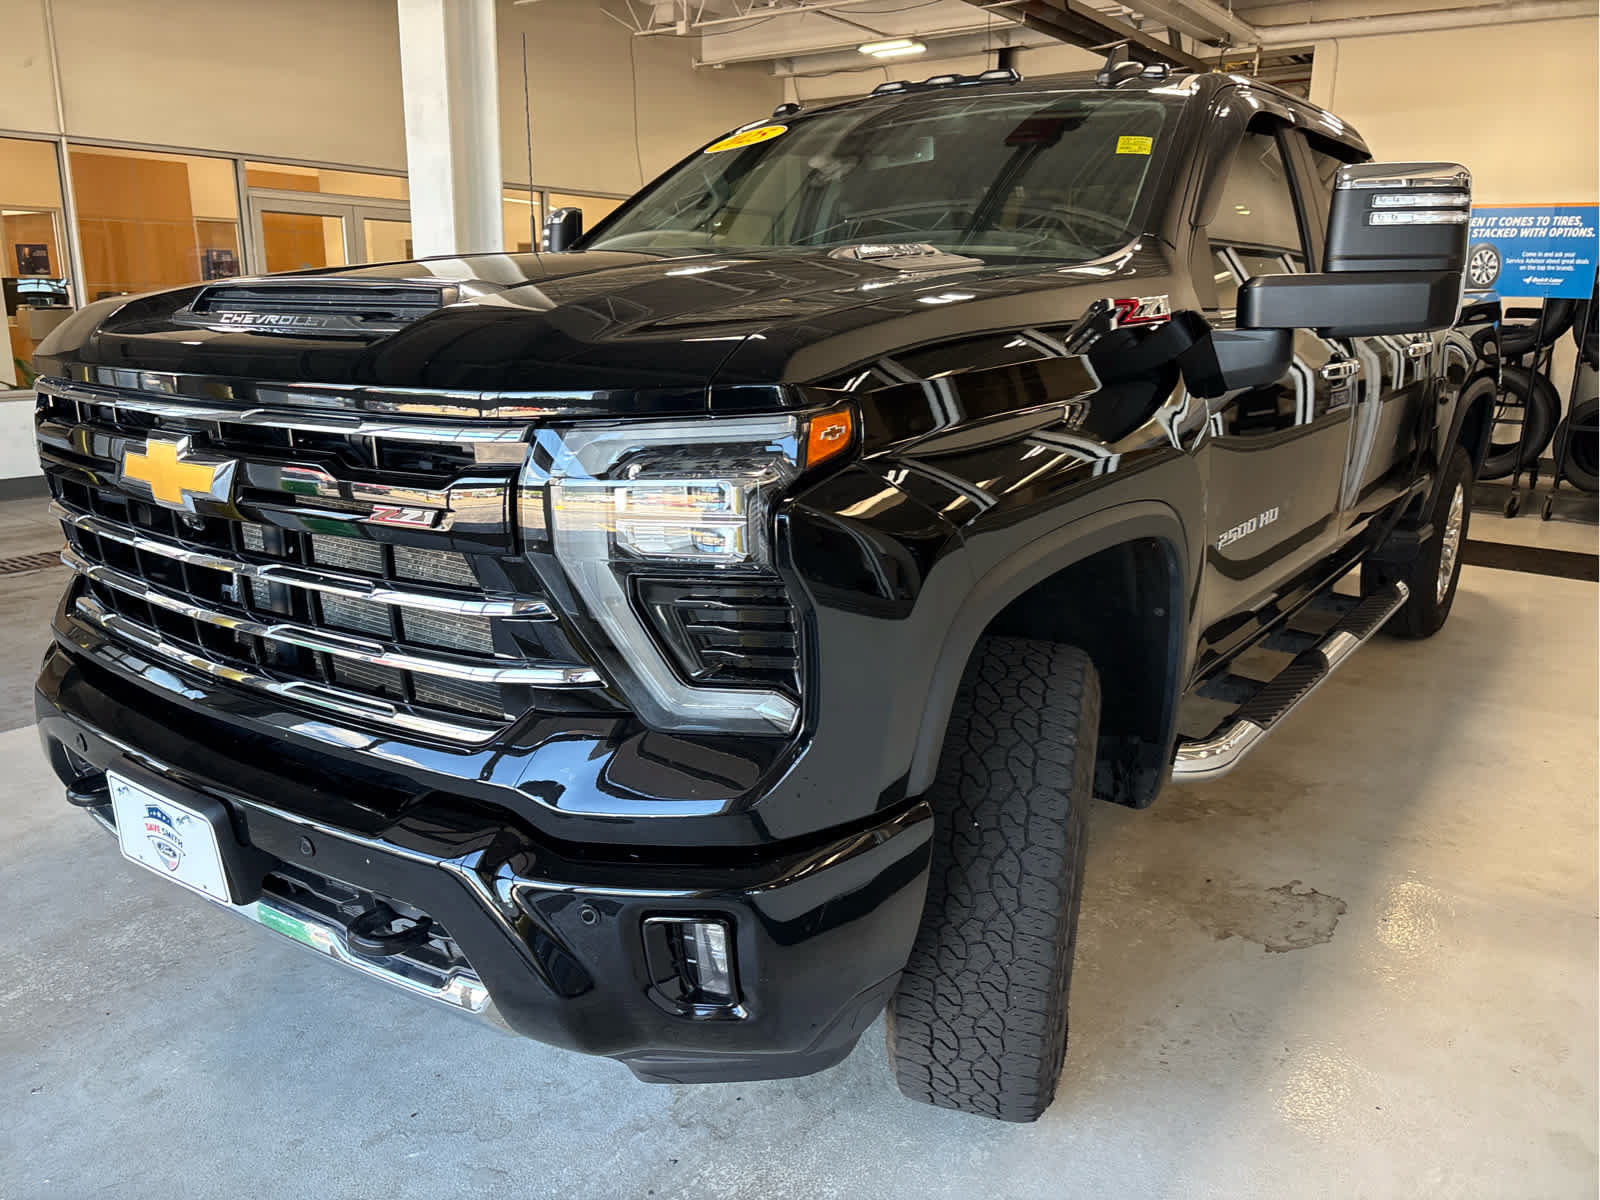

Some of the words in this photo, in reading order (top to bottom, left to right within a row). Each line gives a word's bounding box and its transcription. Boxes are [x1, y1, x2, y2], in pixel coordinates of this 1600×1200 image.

[1470, 217, 1486, 226] EN
[1486, 217, 1498, 226] IT
[1498, 216, 1535, 226] COMES
[1536, 216, 1551, 226] TO
[1552, 215, 1583, 227] TIRES,
[1471, 228, 1518, 238] STACKED
[1519, 228, 1548, 238] WITH
[1548, 227, 1596, 238] OPTIONS.
[219, 312, 331, 328] CHEVROLET
[1109, 294, 1171, 331] Z71
[368, 504, 437, 528] Z71
[1216, 517, 1257, 551] 2500
[1259, 506, 1279, 529] HD
